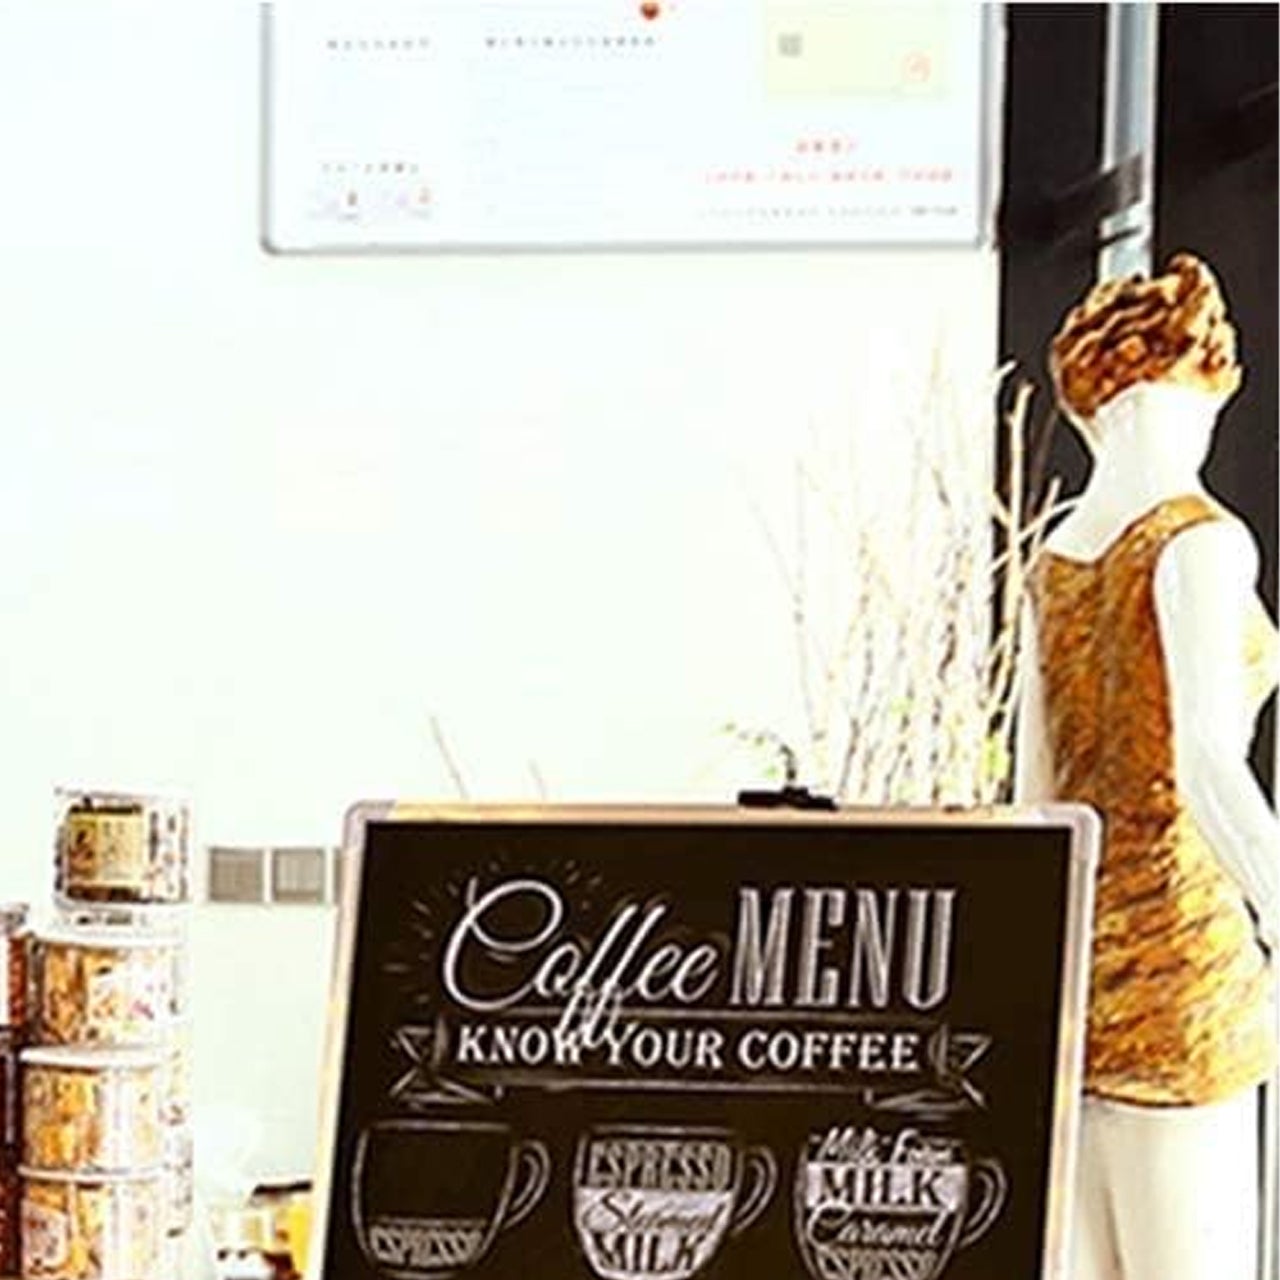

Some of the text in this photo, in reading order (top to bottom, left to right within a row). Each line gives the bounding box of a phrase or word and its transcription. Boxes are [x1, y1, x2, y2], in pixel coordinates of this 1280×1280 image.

[443, 877, 957, 1047] Coffee MENU
[458, 1021, 919, 1071] KNOW YOUR COFFEE
[821, 1169, 943, 1208] MILK
